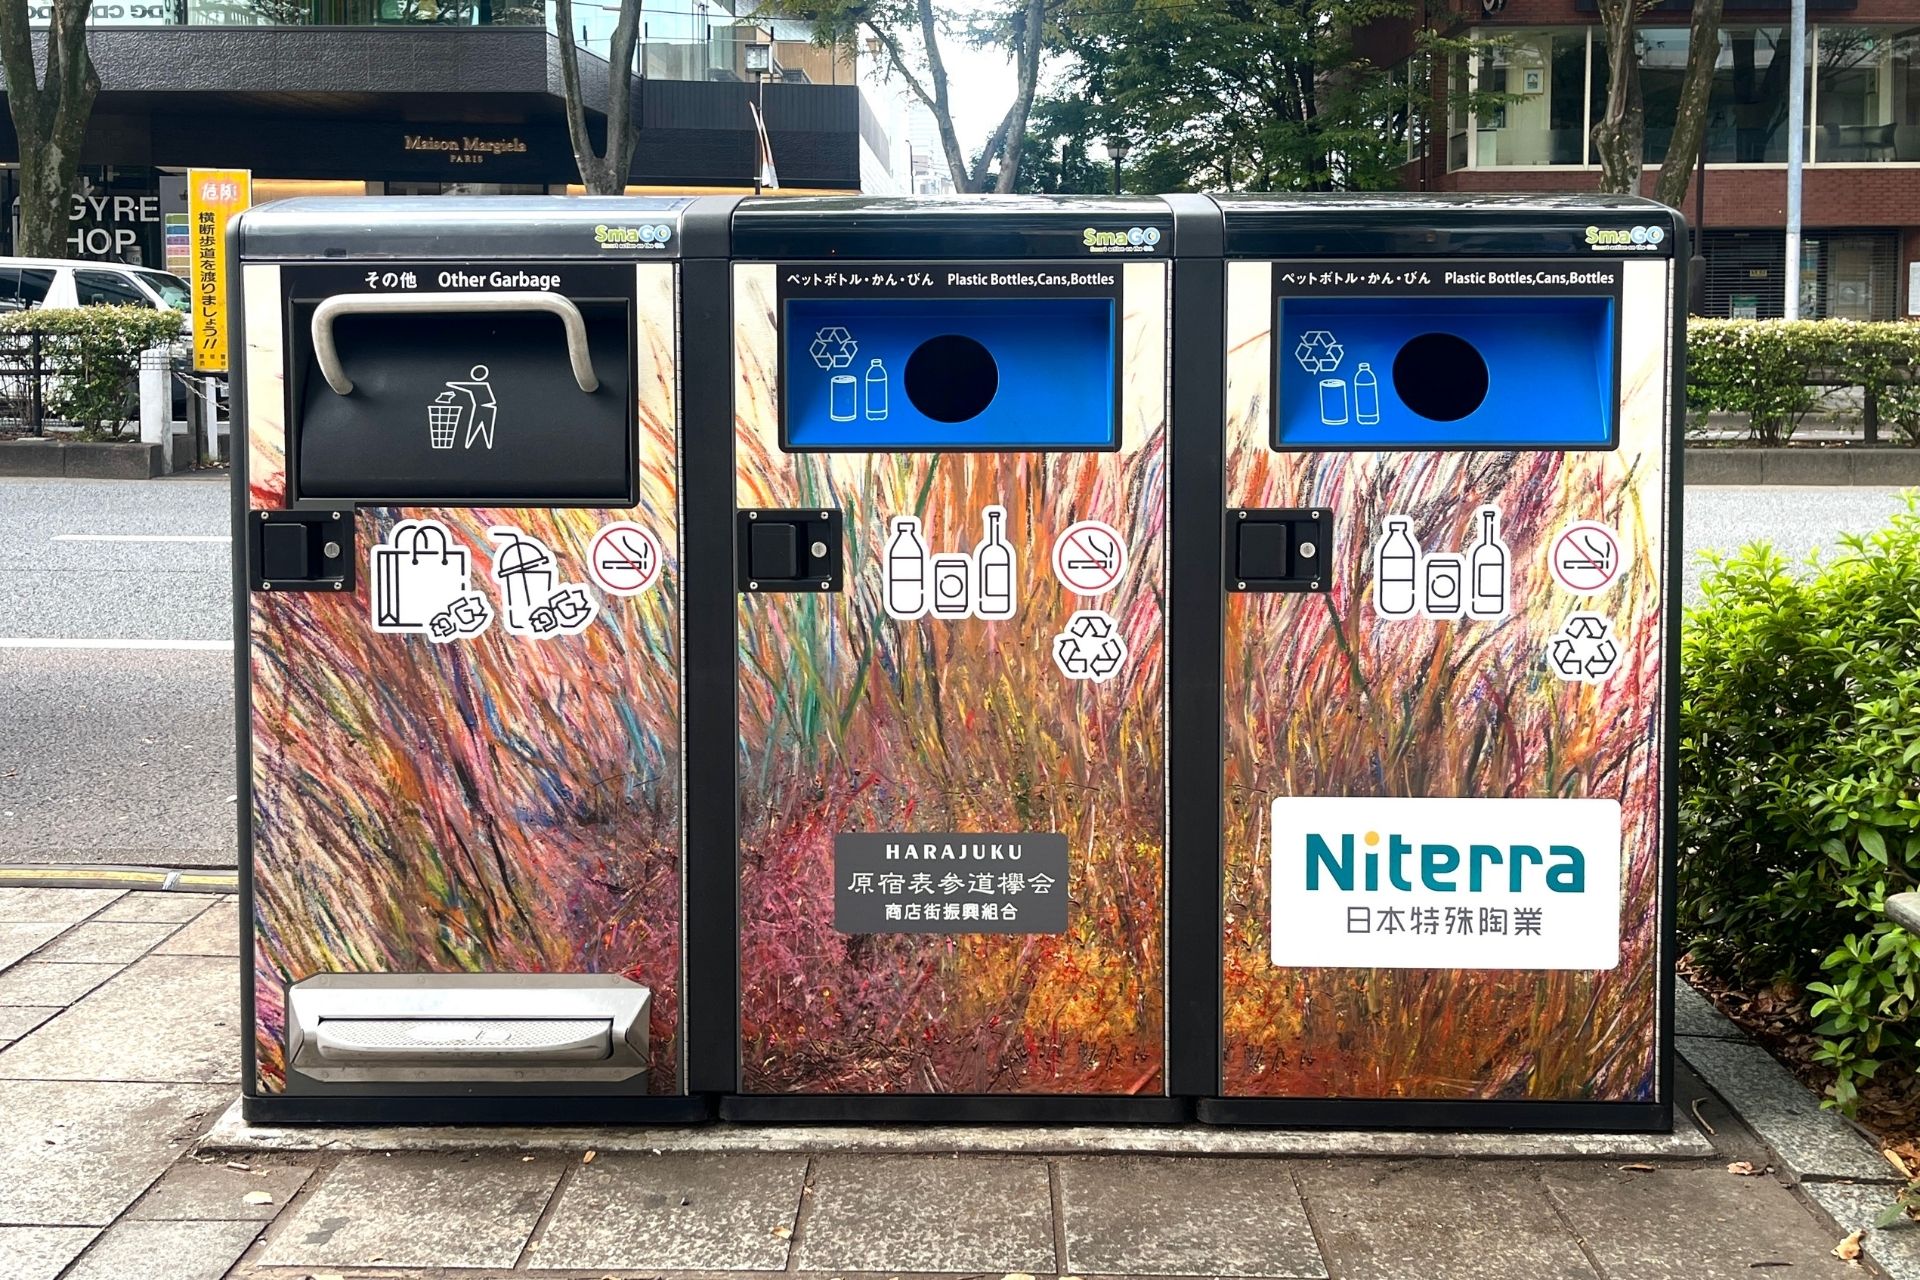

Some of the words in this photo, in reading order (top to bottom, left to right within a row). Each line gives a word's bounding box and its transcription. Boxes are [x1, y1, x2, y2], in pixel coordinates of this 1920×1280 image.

[404, 136, 459, 150] Maison
[463, 137, 527, 154] Margiela
[450, 155, 483, 163] PARIS
[69, 194, 160, 222] GYRE
[595, 225, 671, 243] SmaGO
[1083, 227, 1160, 246] SmaGO
[1585, 226, 1664, 244] SmaGO
[365, 272, 418, 288] その他
[438, 271, 487, 288] Other
[490, 271, 561, 291] Garbage
[786, 273, 934, 287] ペットボトル・かん・びん
[948, 272, 988, 286] Plastic
[991, 272, 1115, 287] Bottles,Cans,Bottles
[1281, 271, 1431, 286] ペットボトル・かん・びん
[1444, 271, 1486, 285] Plastic
[1489, 271, 1615, 286] Bottles,Cans,Bottles
[886, 844, 1022, 860] HARAJUKU
[1306, 831, 1585, 893] Niterra
[885, 903, 1018, 921] 商店街振興組合
[1347, 906, 1543, 936] 日本特殊陶業
